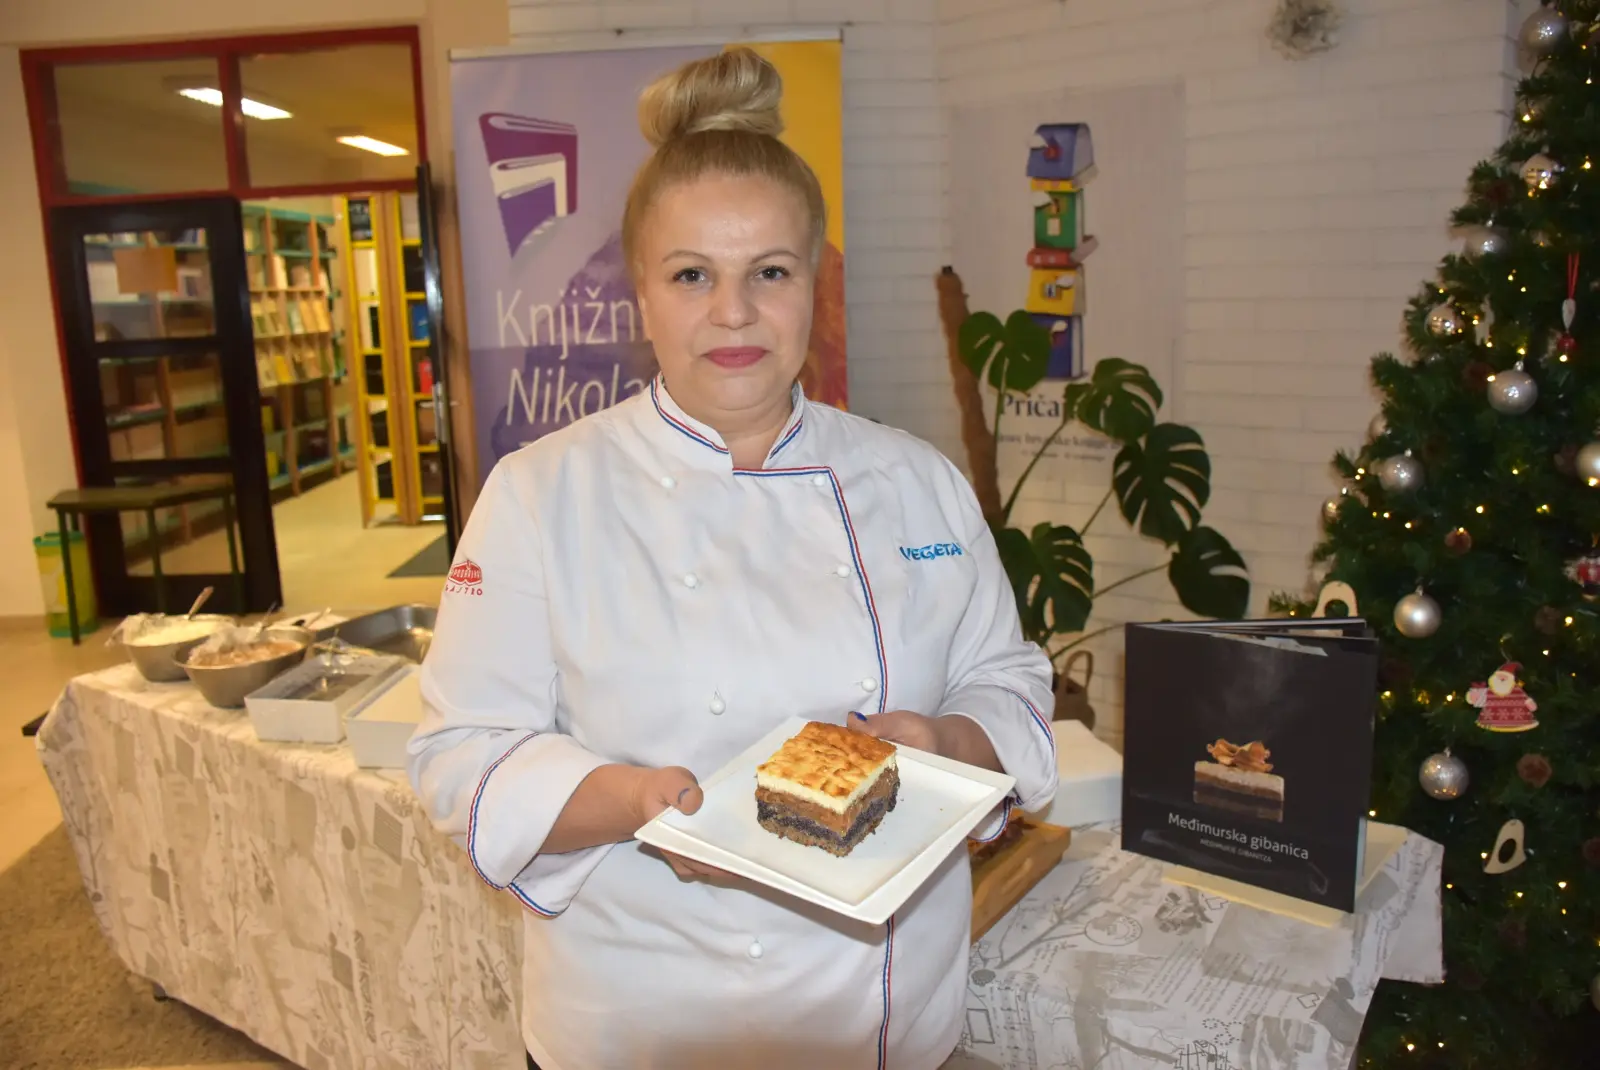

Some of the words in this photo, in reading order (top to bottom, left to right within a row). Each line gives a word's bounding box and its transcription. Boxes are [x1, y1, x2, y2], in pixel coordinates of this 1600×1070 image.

[497, 286, 635, 359] Knjižn
[899, 542, 962, 561] VEGETA
[1168, 812, 1248, 844] Međimurska
[1250, 836, 1309, 860] gibanica
